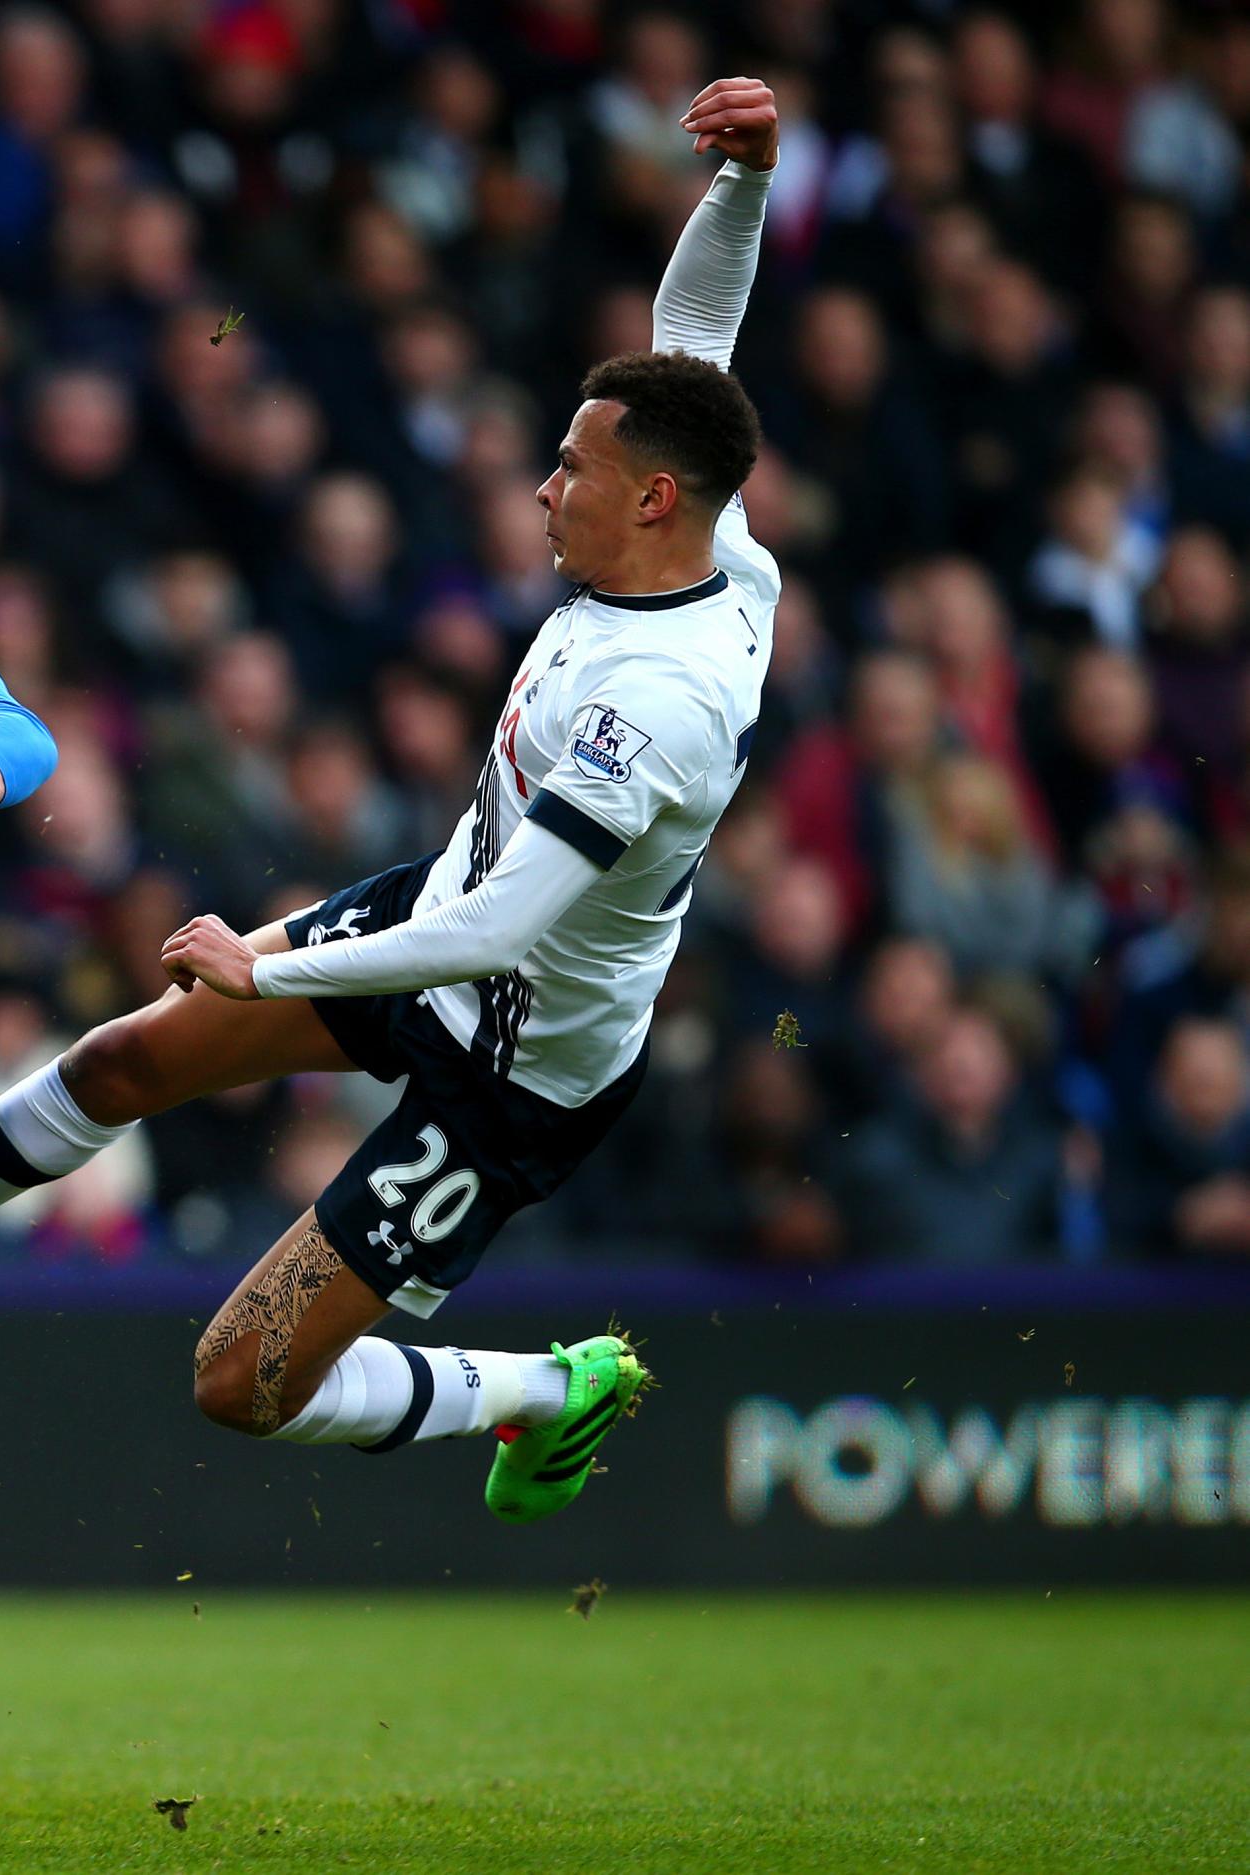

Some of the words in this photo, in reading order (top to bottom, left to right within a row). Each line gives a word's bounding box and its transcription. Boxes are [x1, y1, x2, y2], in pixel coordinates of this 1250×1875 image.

[577, 742, 614, 767] BARCLAYS
[367, 1122, 481, 1244] 20
[726, 1394, 1250, 1527] POWERE
